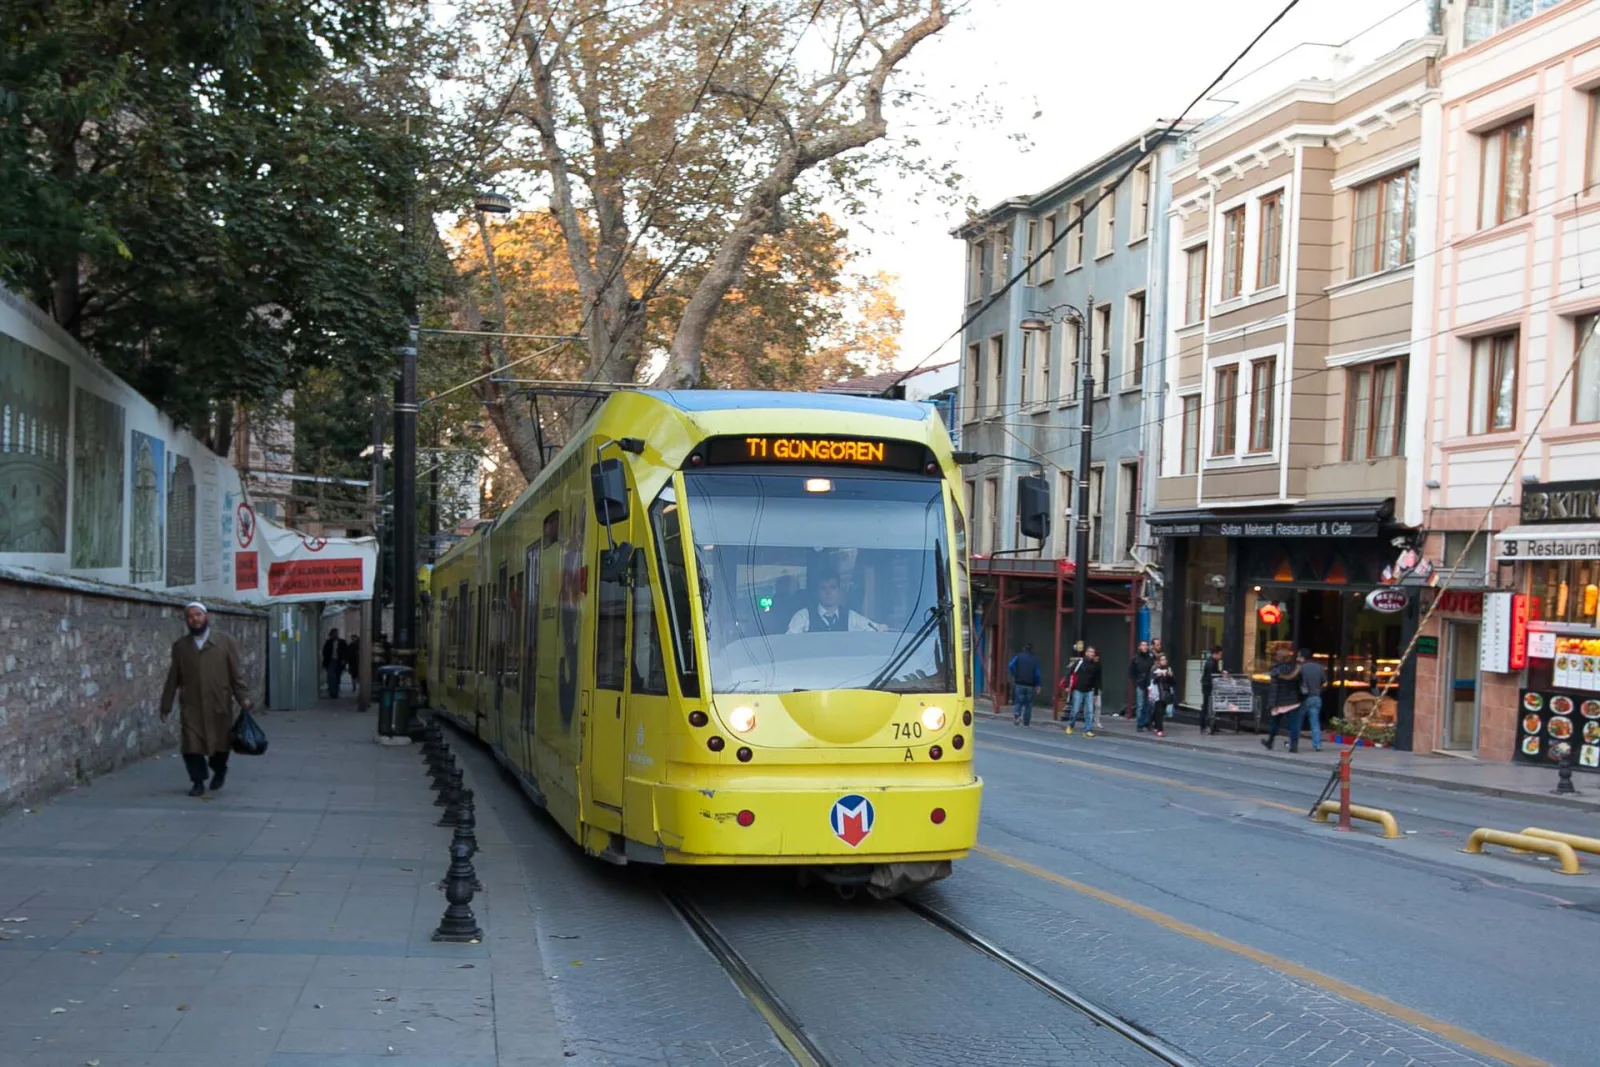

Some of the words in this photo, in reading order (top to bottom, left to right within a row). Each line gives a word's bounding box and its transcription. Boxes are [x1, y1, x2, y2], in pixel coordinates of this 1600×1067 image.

[746, 438, 766, 457] T1
[774, 438, 884, 461] GÜNGÖREN
[1220, 523, 1242, 536] Sultan
[1244, 523, 1274, 536] Mehmet
[1276, 522, 1318, 536] Restaurant
[1320, 521, 1328, 535] &
[1331, 521, 1352, 536] Cafe
[892, 721, 922, 740] 740
[904, 748, 914, 761] A
